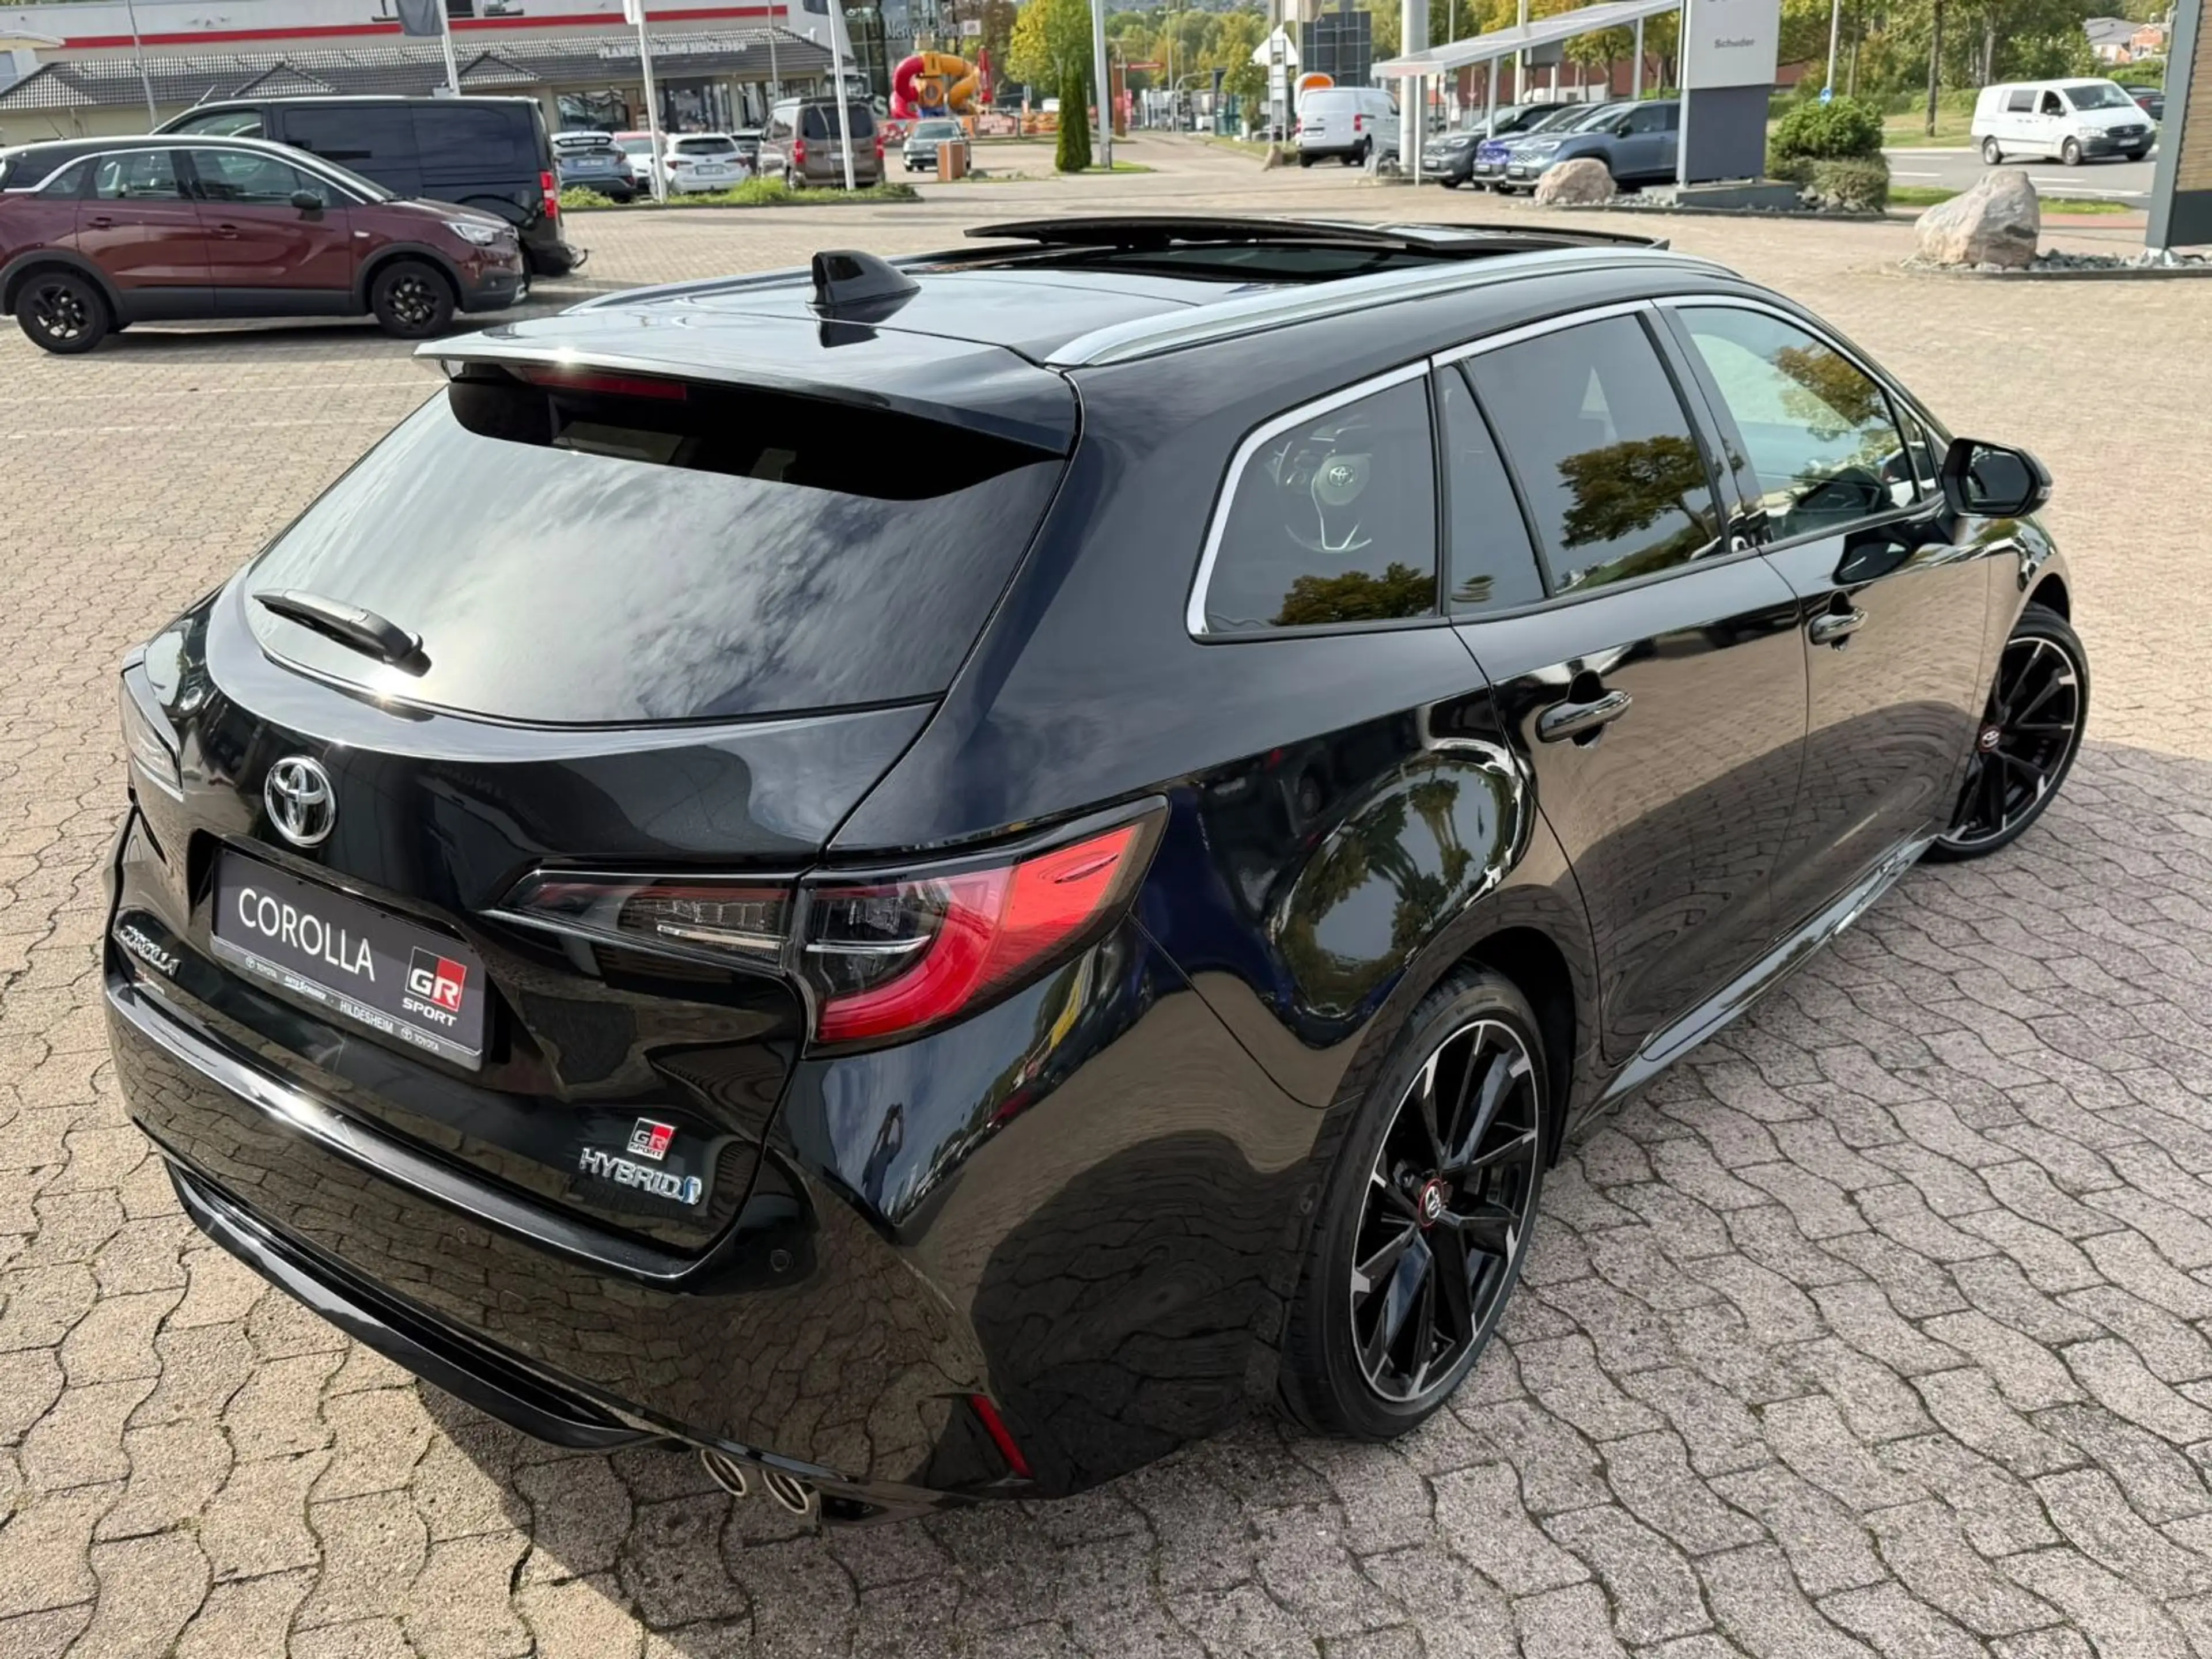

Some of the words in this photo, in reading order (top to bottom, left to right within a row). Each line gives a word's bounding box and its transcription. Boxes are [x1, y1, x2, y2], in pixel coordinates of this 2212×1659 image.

[1715, 38, 1755, 48] Schuder
[238, 888, 376, 981] COROLLA
[410, 968, 459, 1006] GR
[340, 999, 394, 1034] HILDESHEIM
[402, 998, 457, 1027] SPORT
[634, 1130, 666, 1149] GR
[579, 1147, 682, 1201] HYBRID
